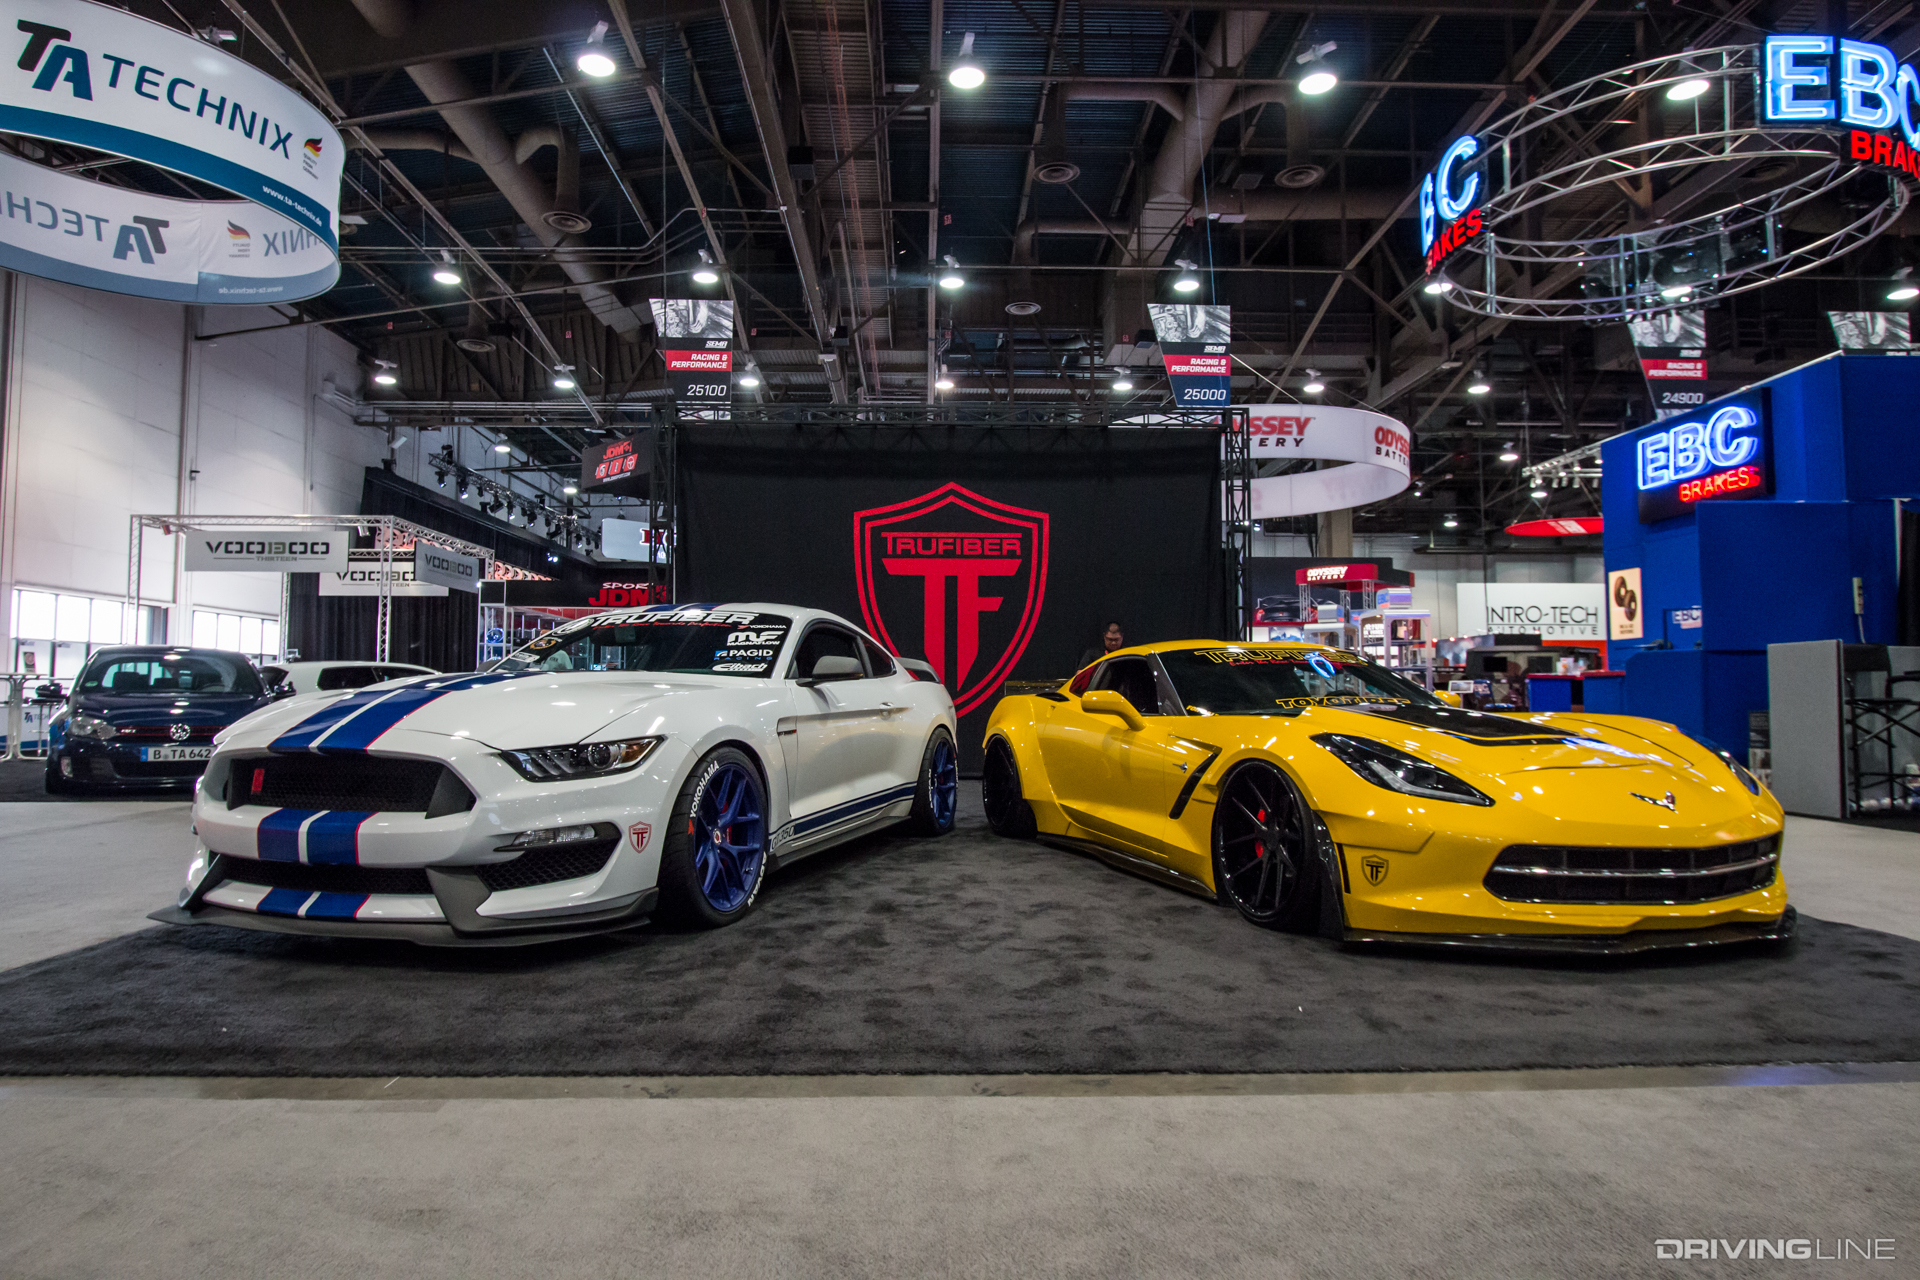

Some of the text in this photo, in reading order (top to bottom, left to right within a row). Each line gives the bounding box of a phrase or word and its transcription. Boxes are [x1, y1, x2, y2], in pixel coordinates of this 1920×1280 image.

[17, 19, 293, 160] TA TECHNIX
[1851, 130, 1920, 180] BRAK
[691, 353, 720, 361] RACING
[1220, 358, 1227, 366] &
[671, 361, 728, 369] PERFORMANCE
[1171, 365, 1227, 373] PERFORMANCE
[687, 384, 728, 396] 25100
[1183, 388, 1227, 401] 25000
[1662, 392, 1704, 404] 24900
[1637, 405, 1758, 491] EBC
[1679, 465, 1761, 502] BRAKES
[881, 531, 1022, 556] TRUFIBER
[1306, 566, 1348, 577] ODYSSEY
[591, 612, 759, 628] TRUFIBER
[1487, 605, 1598, 624] INTRO-TECH
[1674, 609, 1700, 622] EBC
[729, 649, 773, 657] PAGID
[153, 749, 161, 760] B
[690, 760, 720, 818] YOKOHAMA
